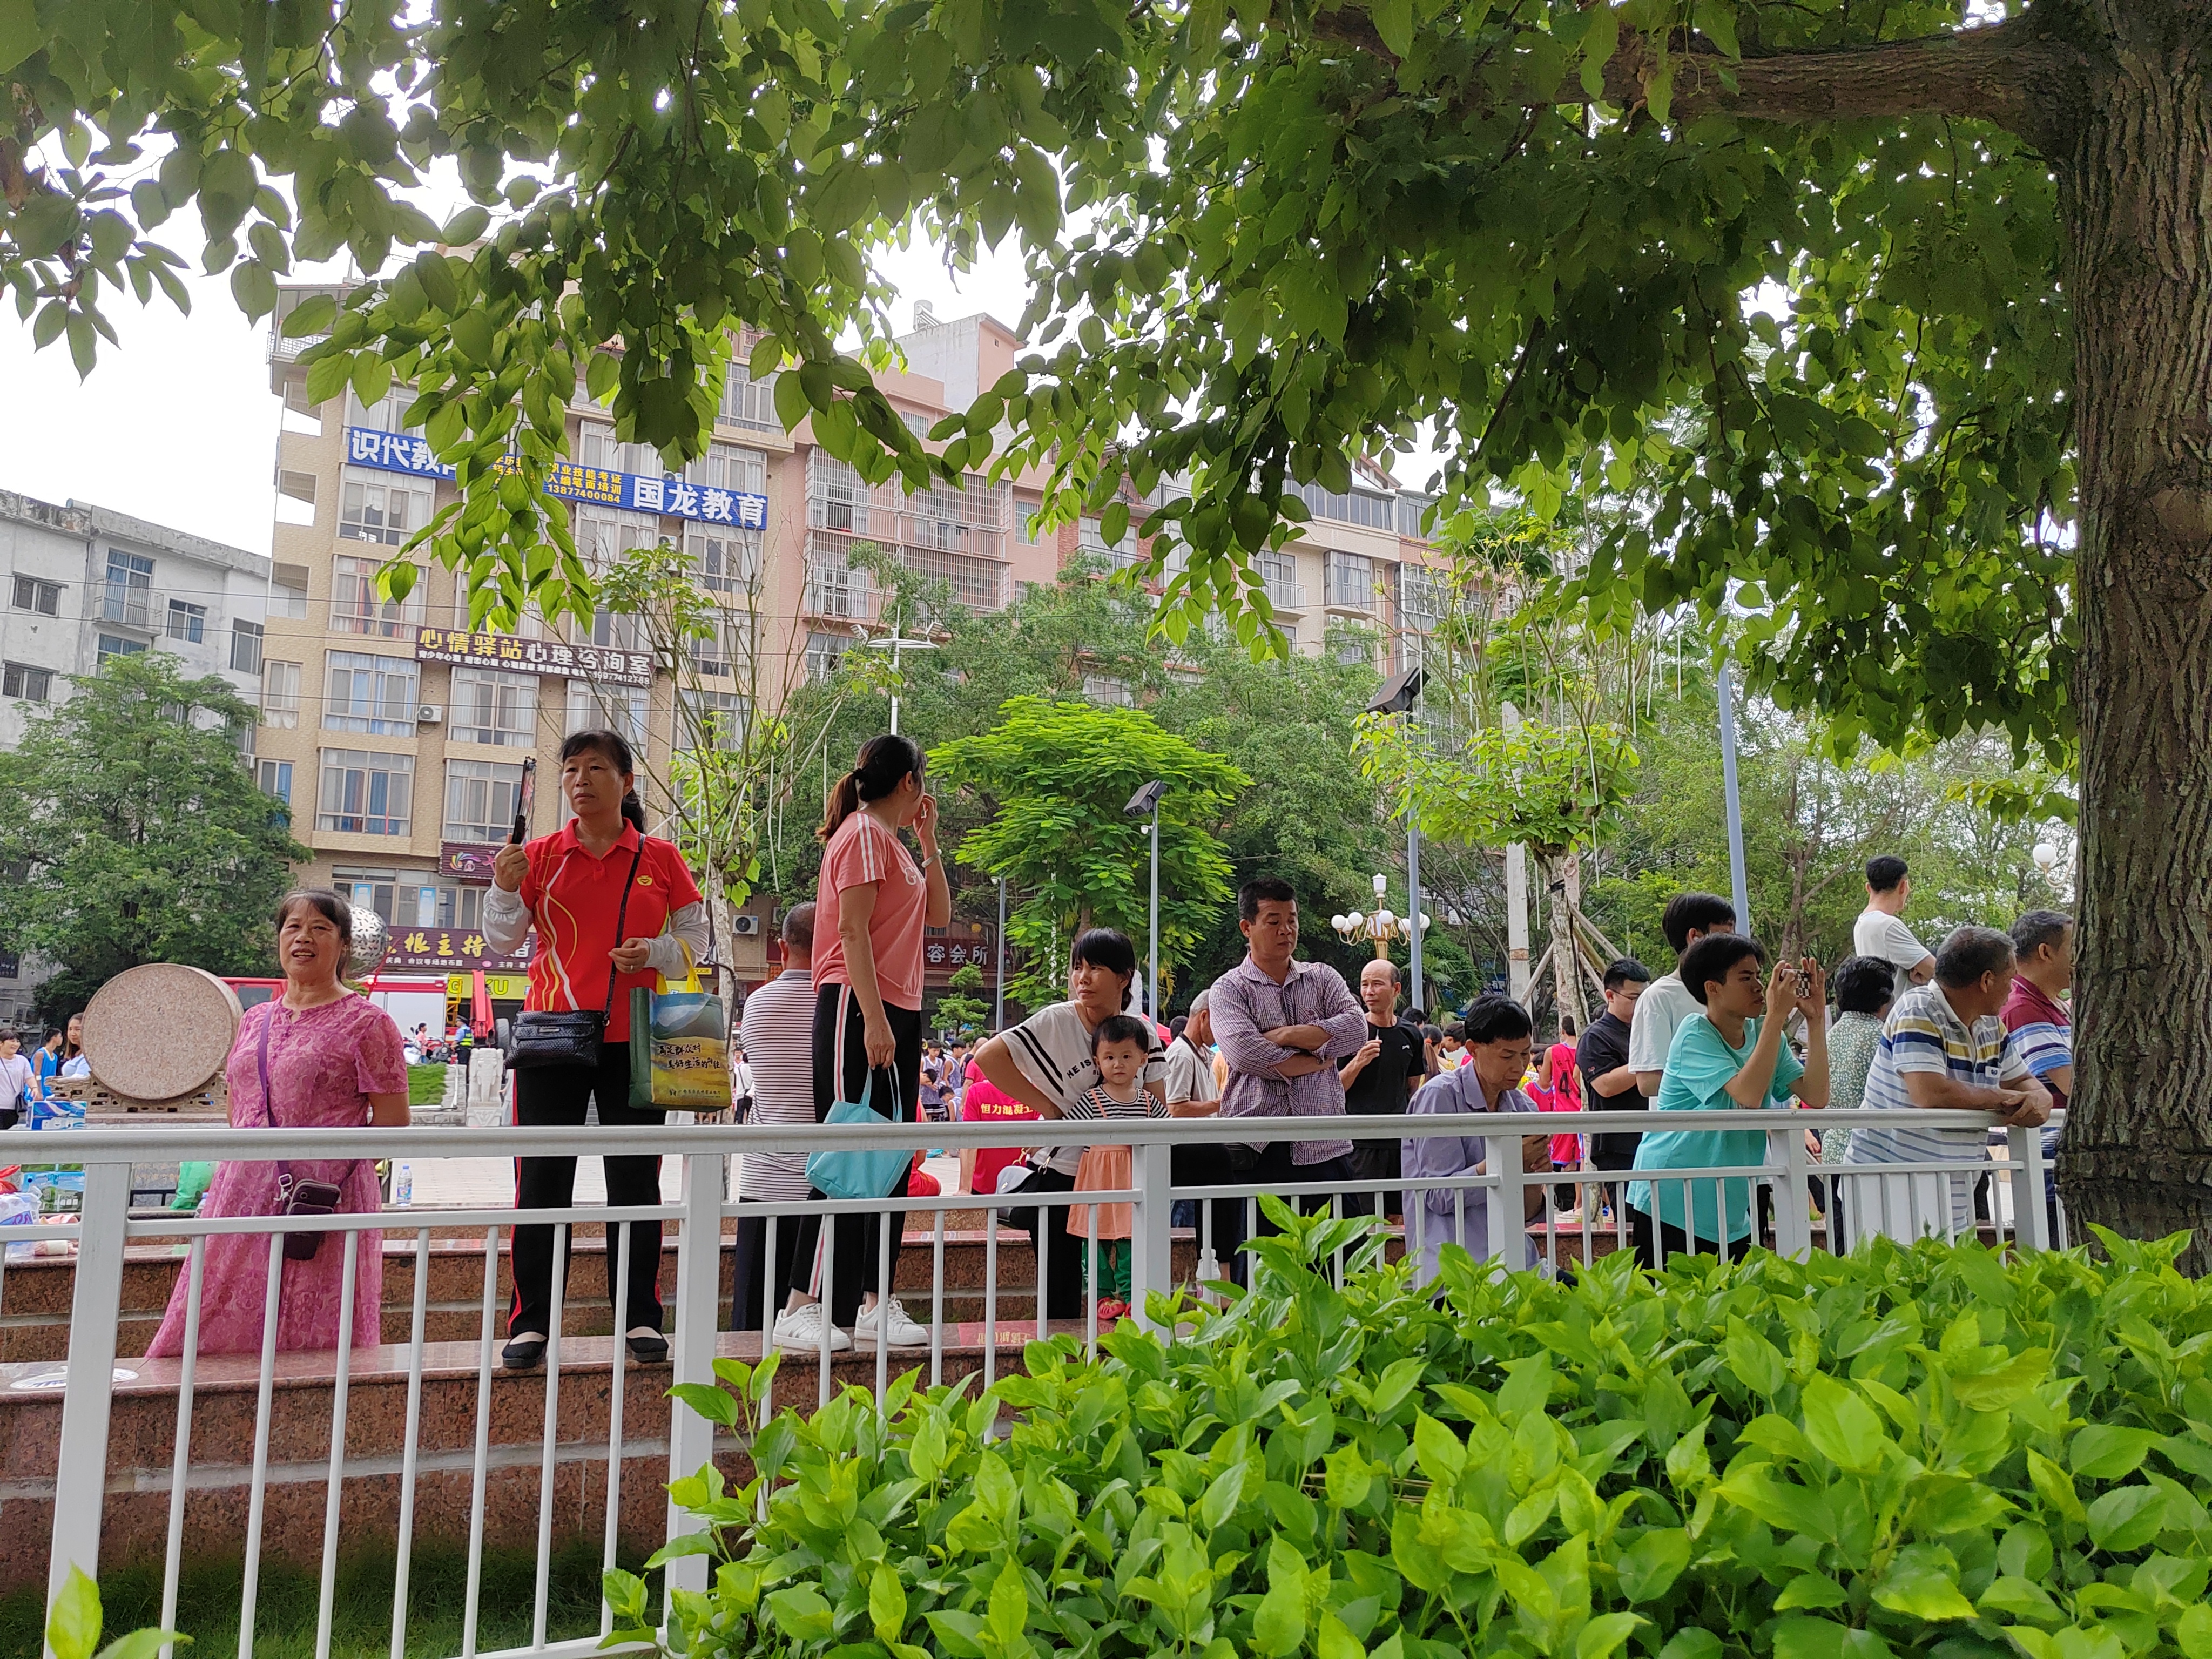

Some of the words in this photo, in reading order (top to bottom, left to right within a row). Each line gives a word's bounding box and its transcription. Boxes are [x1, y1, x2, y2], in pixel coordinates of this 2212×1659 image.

[548, 484, 621, 503] 13877400084
[633, 476, 767, 527] 国龙教育
[419, 629, 650, 675] 心情驿站心理咨询室
[387, 932, 487, 957] 根主持
[927, 943, 989, 965] 容会所
[1066, 1065, 1080, 1080] HE
[1080, 1058, 1092, 1069] IS
